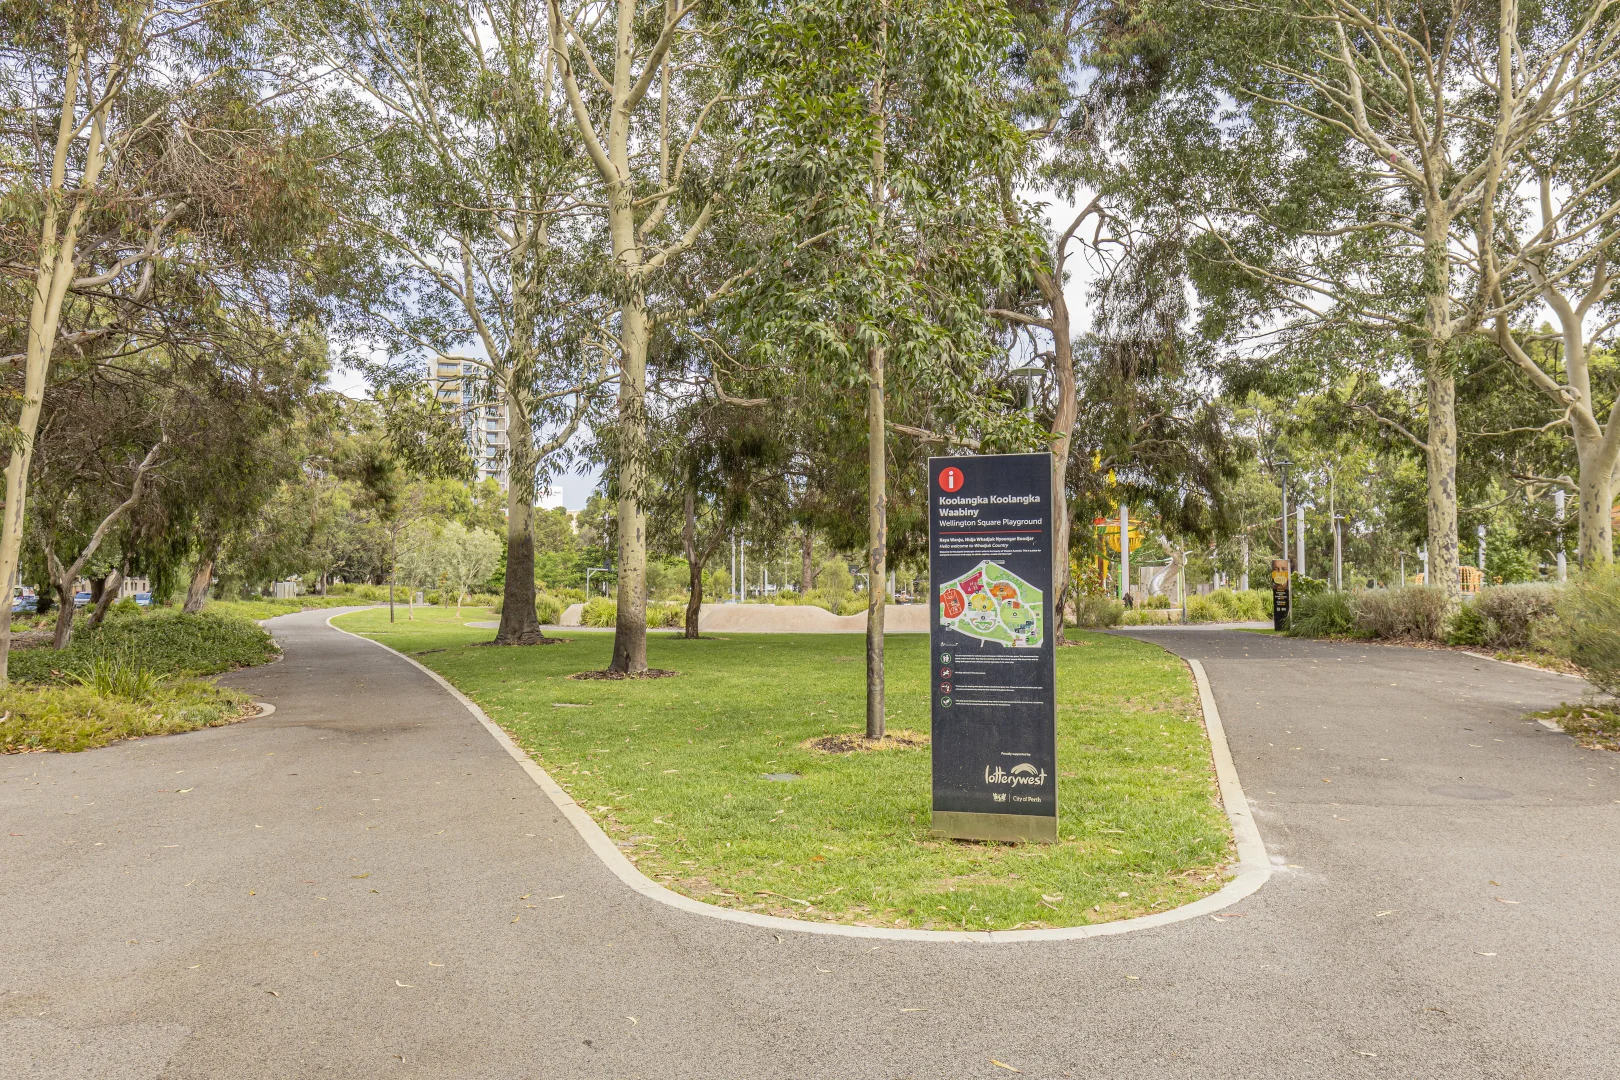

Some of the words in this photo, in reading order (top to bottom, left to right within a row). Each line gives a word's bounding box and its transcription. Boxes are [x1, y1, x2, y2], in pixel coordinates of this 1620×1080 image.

[939, 496, 988, 506] Koolangka
[990, 494, 1040, 504] Koolangka
[939, 508, 979, 518] Waabiny
[939, 519, 976, 527] Wellington
[977, 519, 1001, 527] Square
[1002, 518, 1042, 526] Playground
[985, 765, 1047, 787] lotterywest
